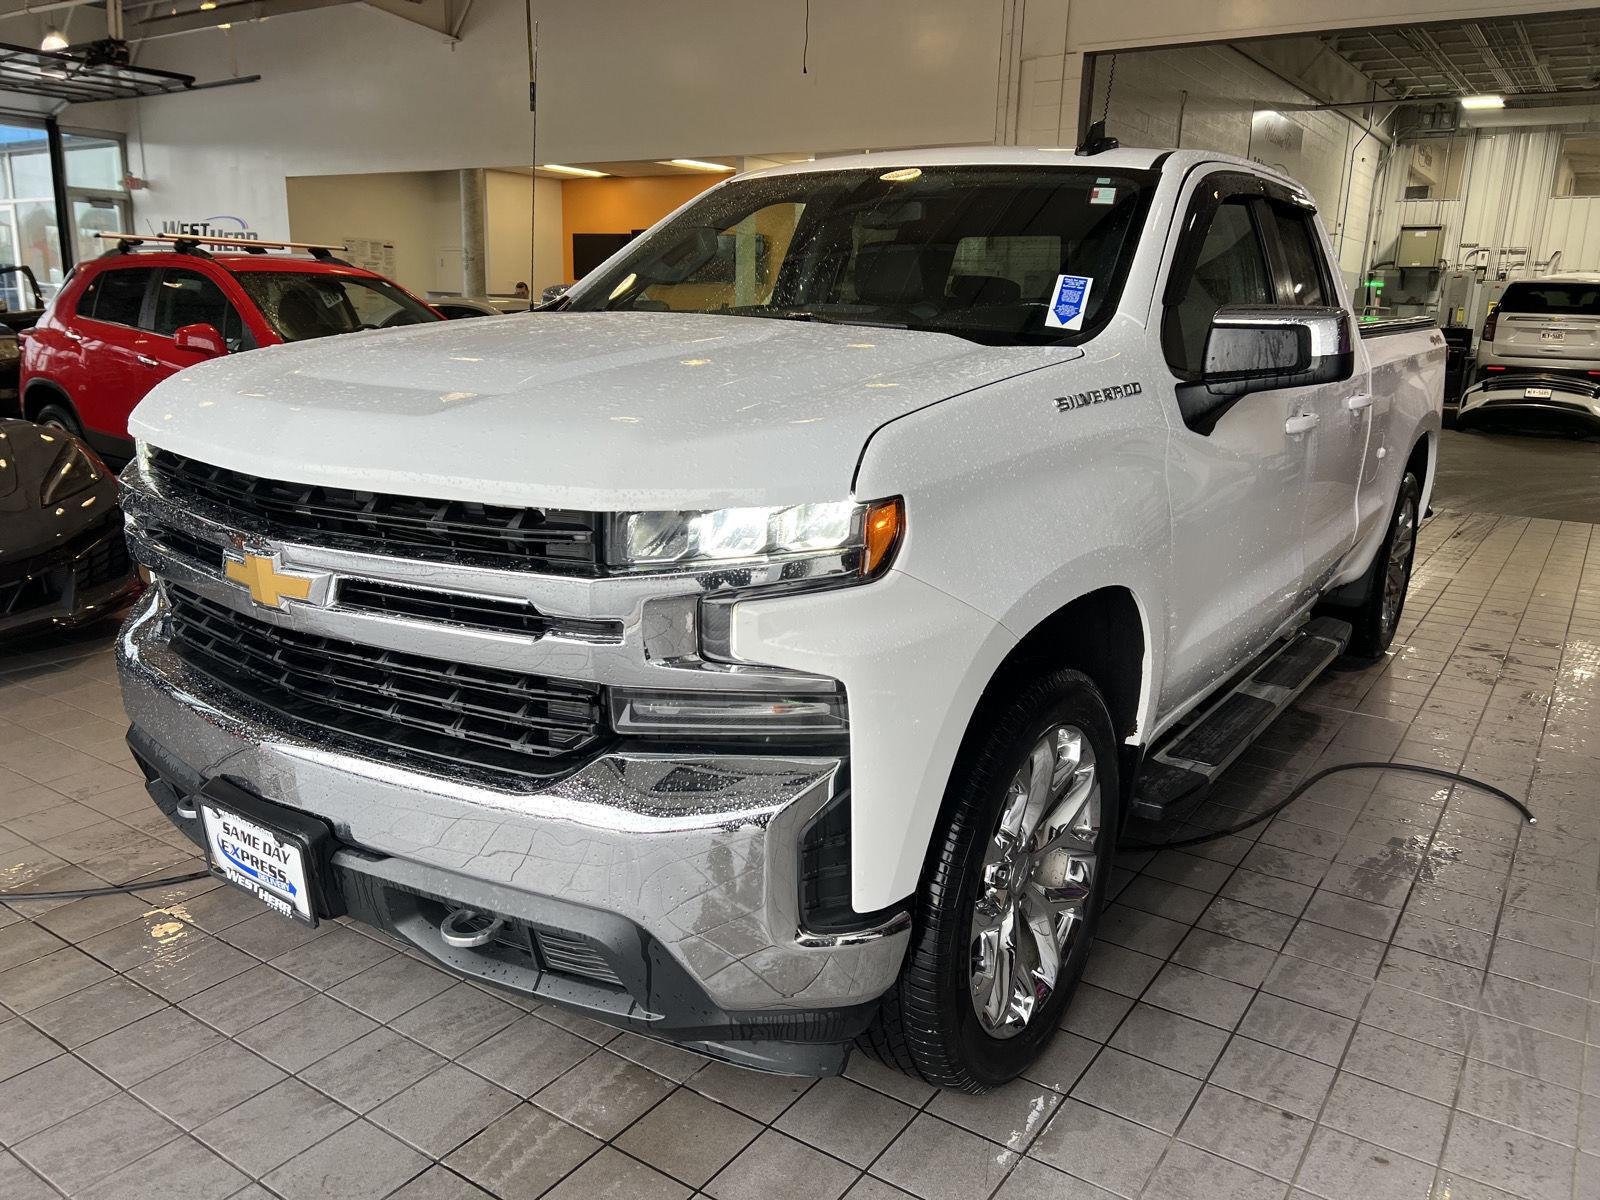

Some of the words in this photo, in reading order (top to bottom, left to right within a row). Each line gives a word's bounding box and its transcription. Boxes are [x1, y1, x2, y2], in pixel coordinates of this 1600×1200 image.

[1052, 382, 1142, 412] SILVERADO
[221, 838, 287, 883] EXPRESS
[222, 821, 260, 850] SAME
[262, 841, 291, 865] DAY
